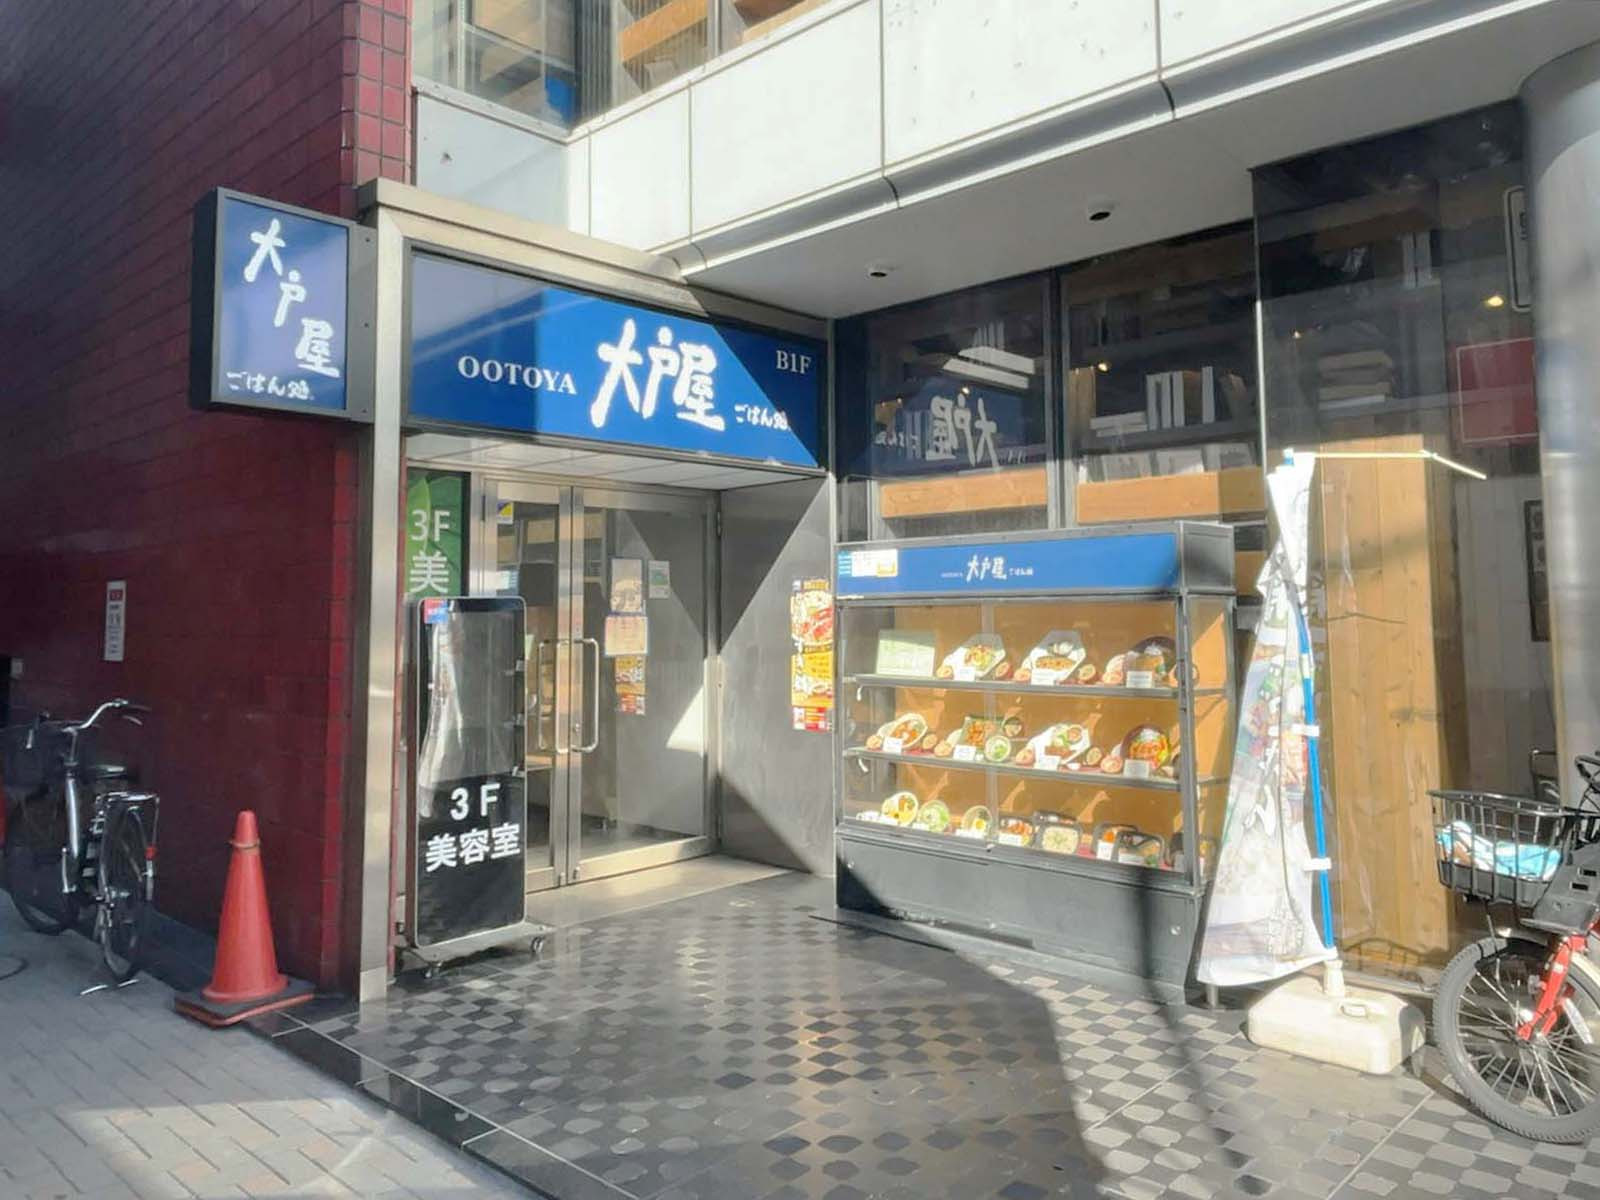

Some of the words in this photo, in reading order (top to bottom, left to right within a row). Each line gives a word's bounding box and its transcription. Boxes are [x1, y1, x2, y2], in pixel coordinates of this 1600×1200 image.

[244, 219, 340, 378] 大戸屋
[457, 355, 577, 396] OOTOYA
[590, 319, 725, 432] 大戸屋
[775, 349, 812, 375] B1F
[226, 371, 310, 400] ごはん処
[734, 403, 788, 430] ごはん処
[411, 508, 451, 542] 3F
[409, 551, 448, 594] 美
[966, 554, 1007, 582] 大戸屋
[425, 822, 521, 873] 美容室
